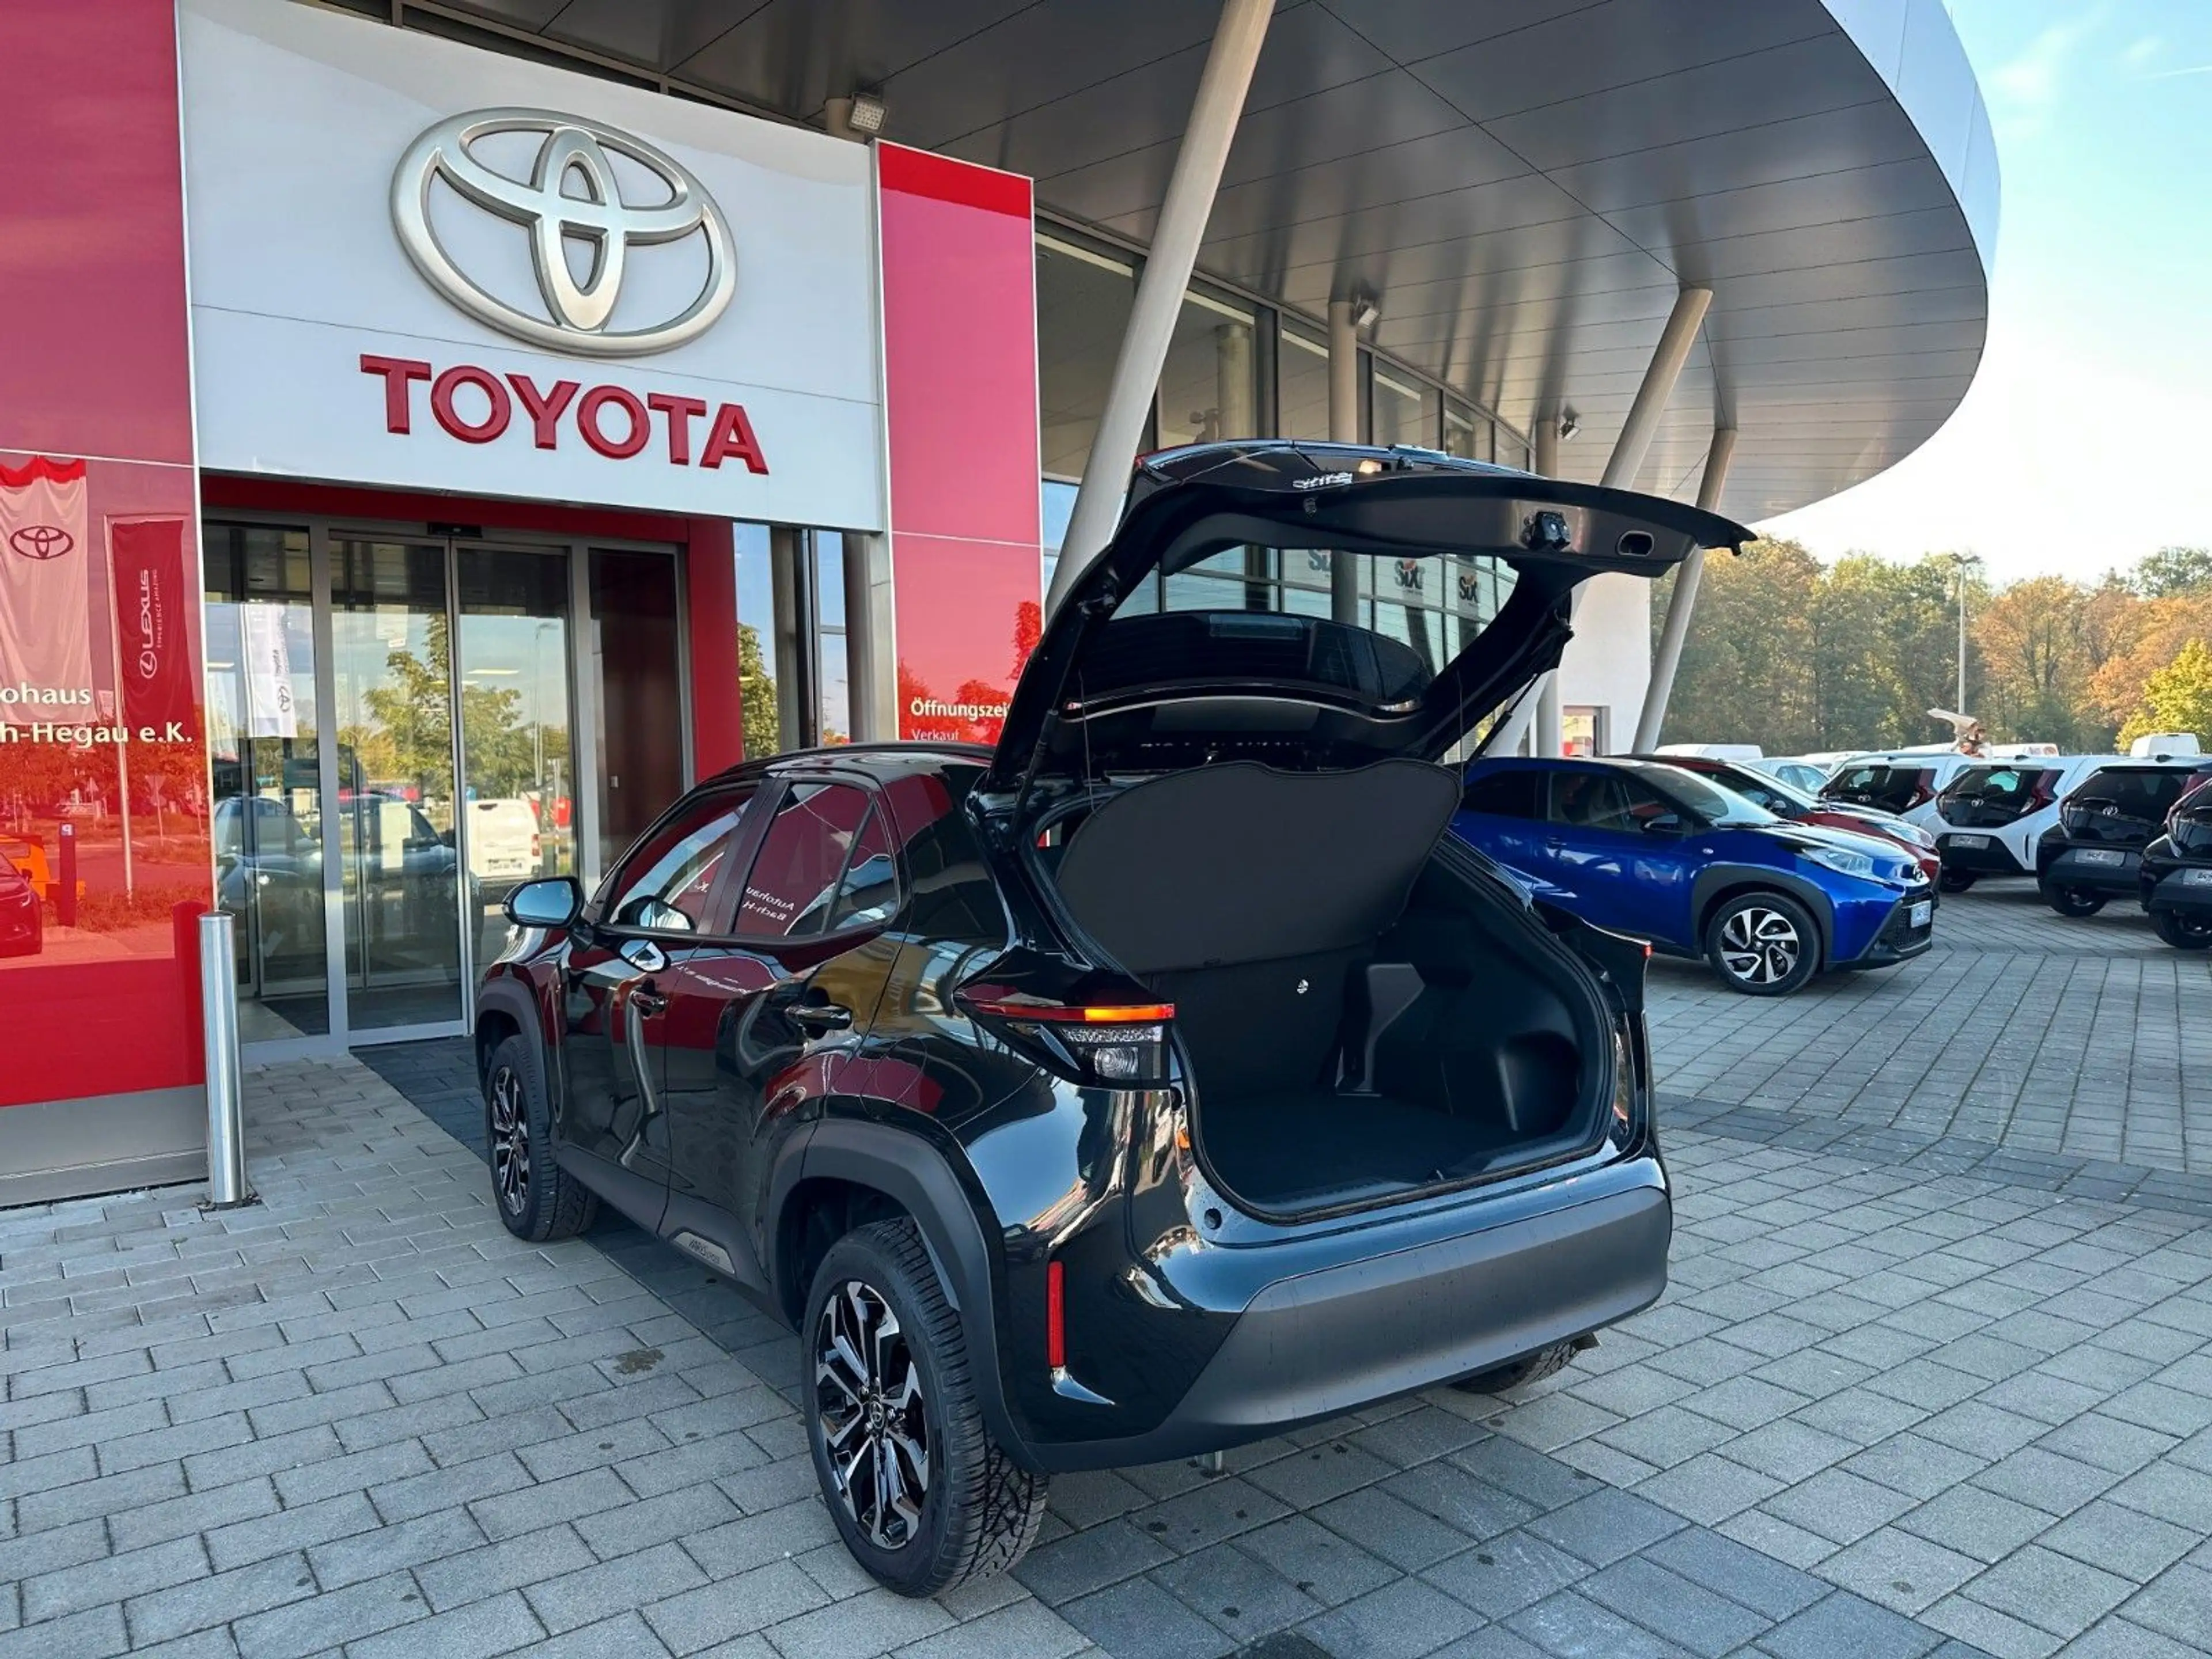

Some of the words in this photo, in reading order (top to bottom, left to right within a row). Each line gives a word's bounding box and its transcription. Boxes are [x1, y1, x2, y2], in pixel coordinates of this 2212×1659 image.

[360, 354, 769, 475] TOYOTA
[140, 569, 154, 649] LEXUS
[139, 721, 193, 743] e.K.
[911, 728, 960, 741] Verkauf
